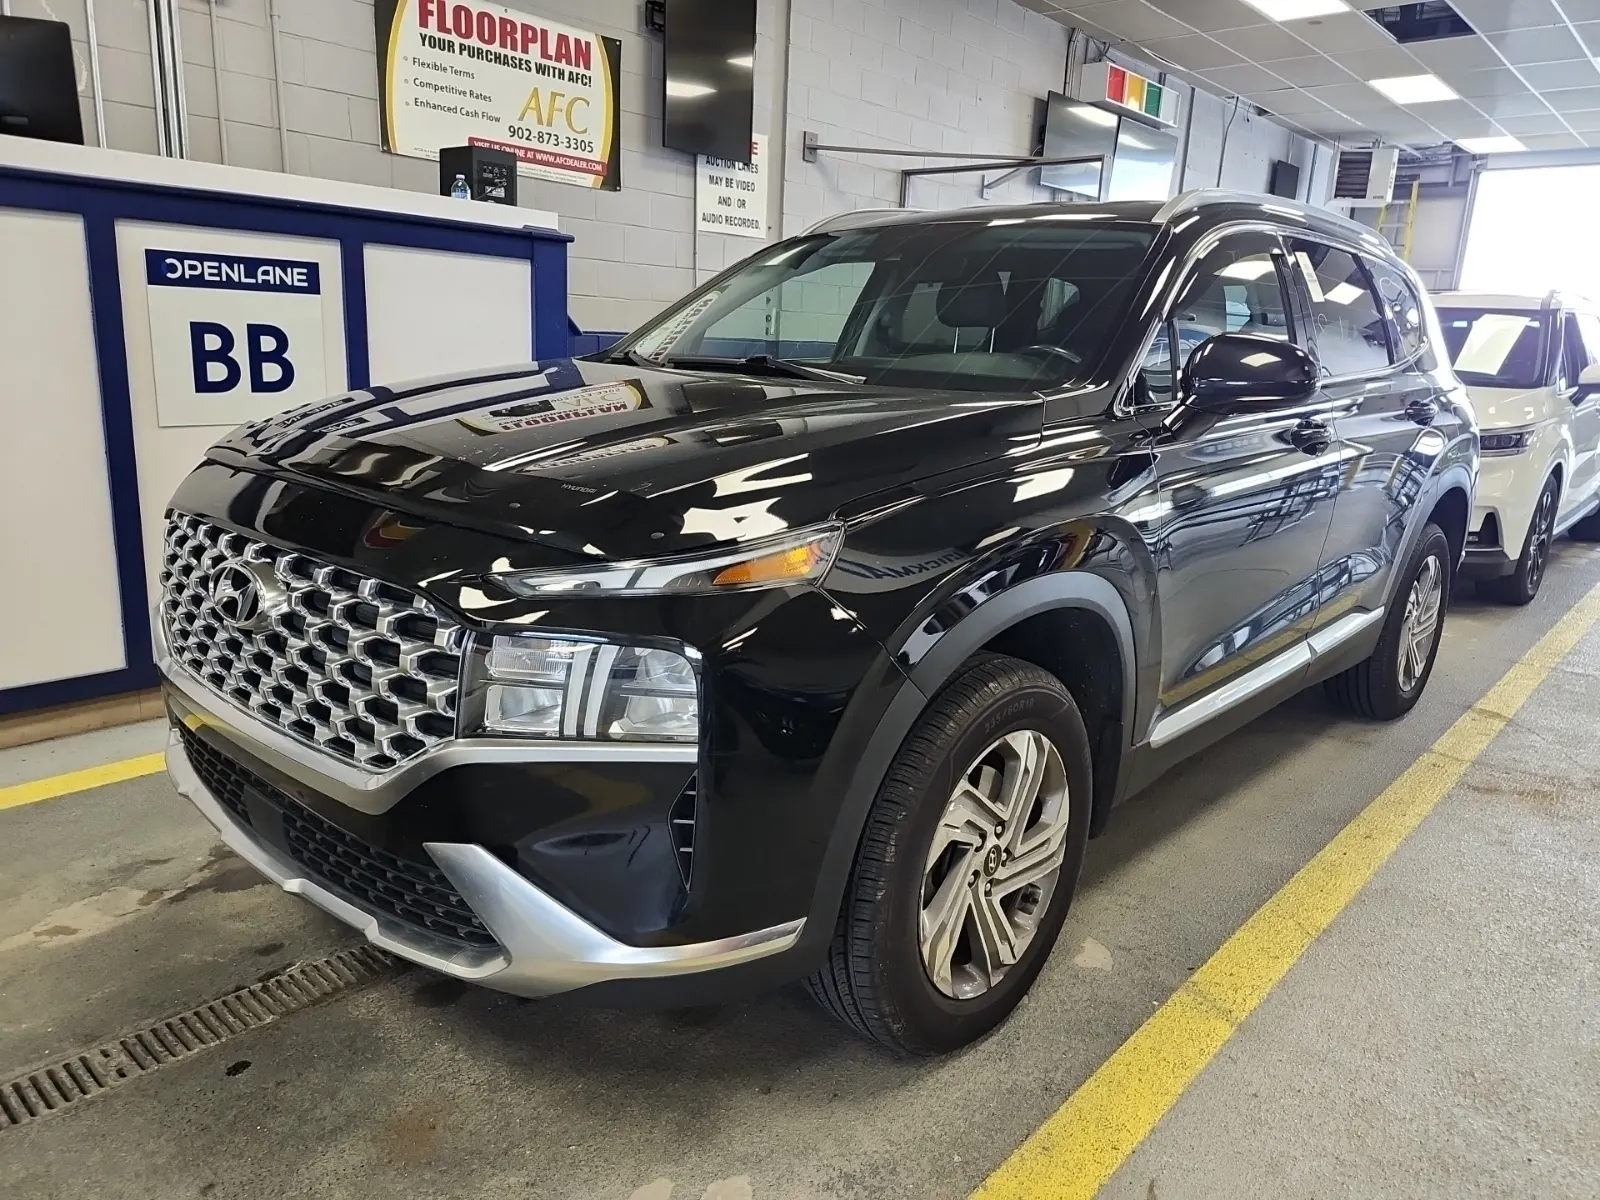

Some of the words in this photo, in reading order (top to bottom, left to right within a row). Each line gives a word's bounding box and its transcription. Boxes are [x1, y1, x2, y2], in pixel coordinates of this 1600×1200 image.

[418, 0, 592, 71] FLOORPLAN
[412, 57, 448, 74] Flexible
[448, 65, 475, 80] Terms
[419, 32, 456, 55] YOUR
[458, 42, 532, 73] PURCHASES
[534, 61, 566, 81] WITH
[567, 70, 593, 88] AFC!
[413, 77, 468, 98] Competitive
[469, 89, 492, 103] Rates
[414, 97, 458, 114] Enhanced
[459, 106, 480, 119] Cash
[481, 111, 501, 123] Flow
[517, 86, 591, 135] AFC
[508, 124, 594, 153] 902-873-3305
[526, 151, 534, 159] AT
[535, 151, 603, 172] WWW.AFCDEALER.COM
[705, 155, 736, 171] AUCTION
[708, 174, 723, 187] MAY
[725, 178, 734, 189] BE
[735, 179, 756, 192] VIDEO
[717, 195, 732, 208] AND
[737, 198, 747, 209] OR
[701, 212, 723, 225] AUDIO
[724, 215, 761, 230] RECORDED.
[163, 257, 309, 287] OPENLANE
[189, 321, 295, 394] BB
[560, 483, 598, 495] HYUNDAI
